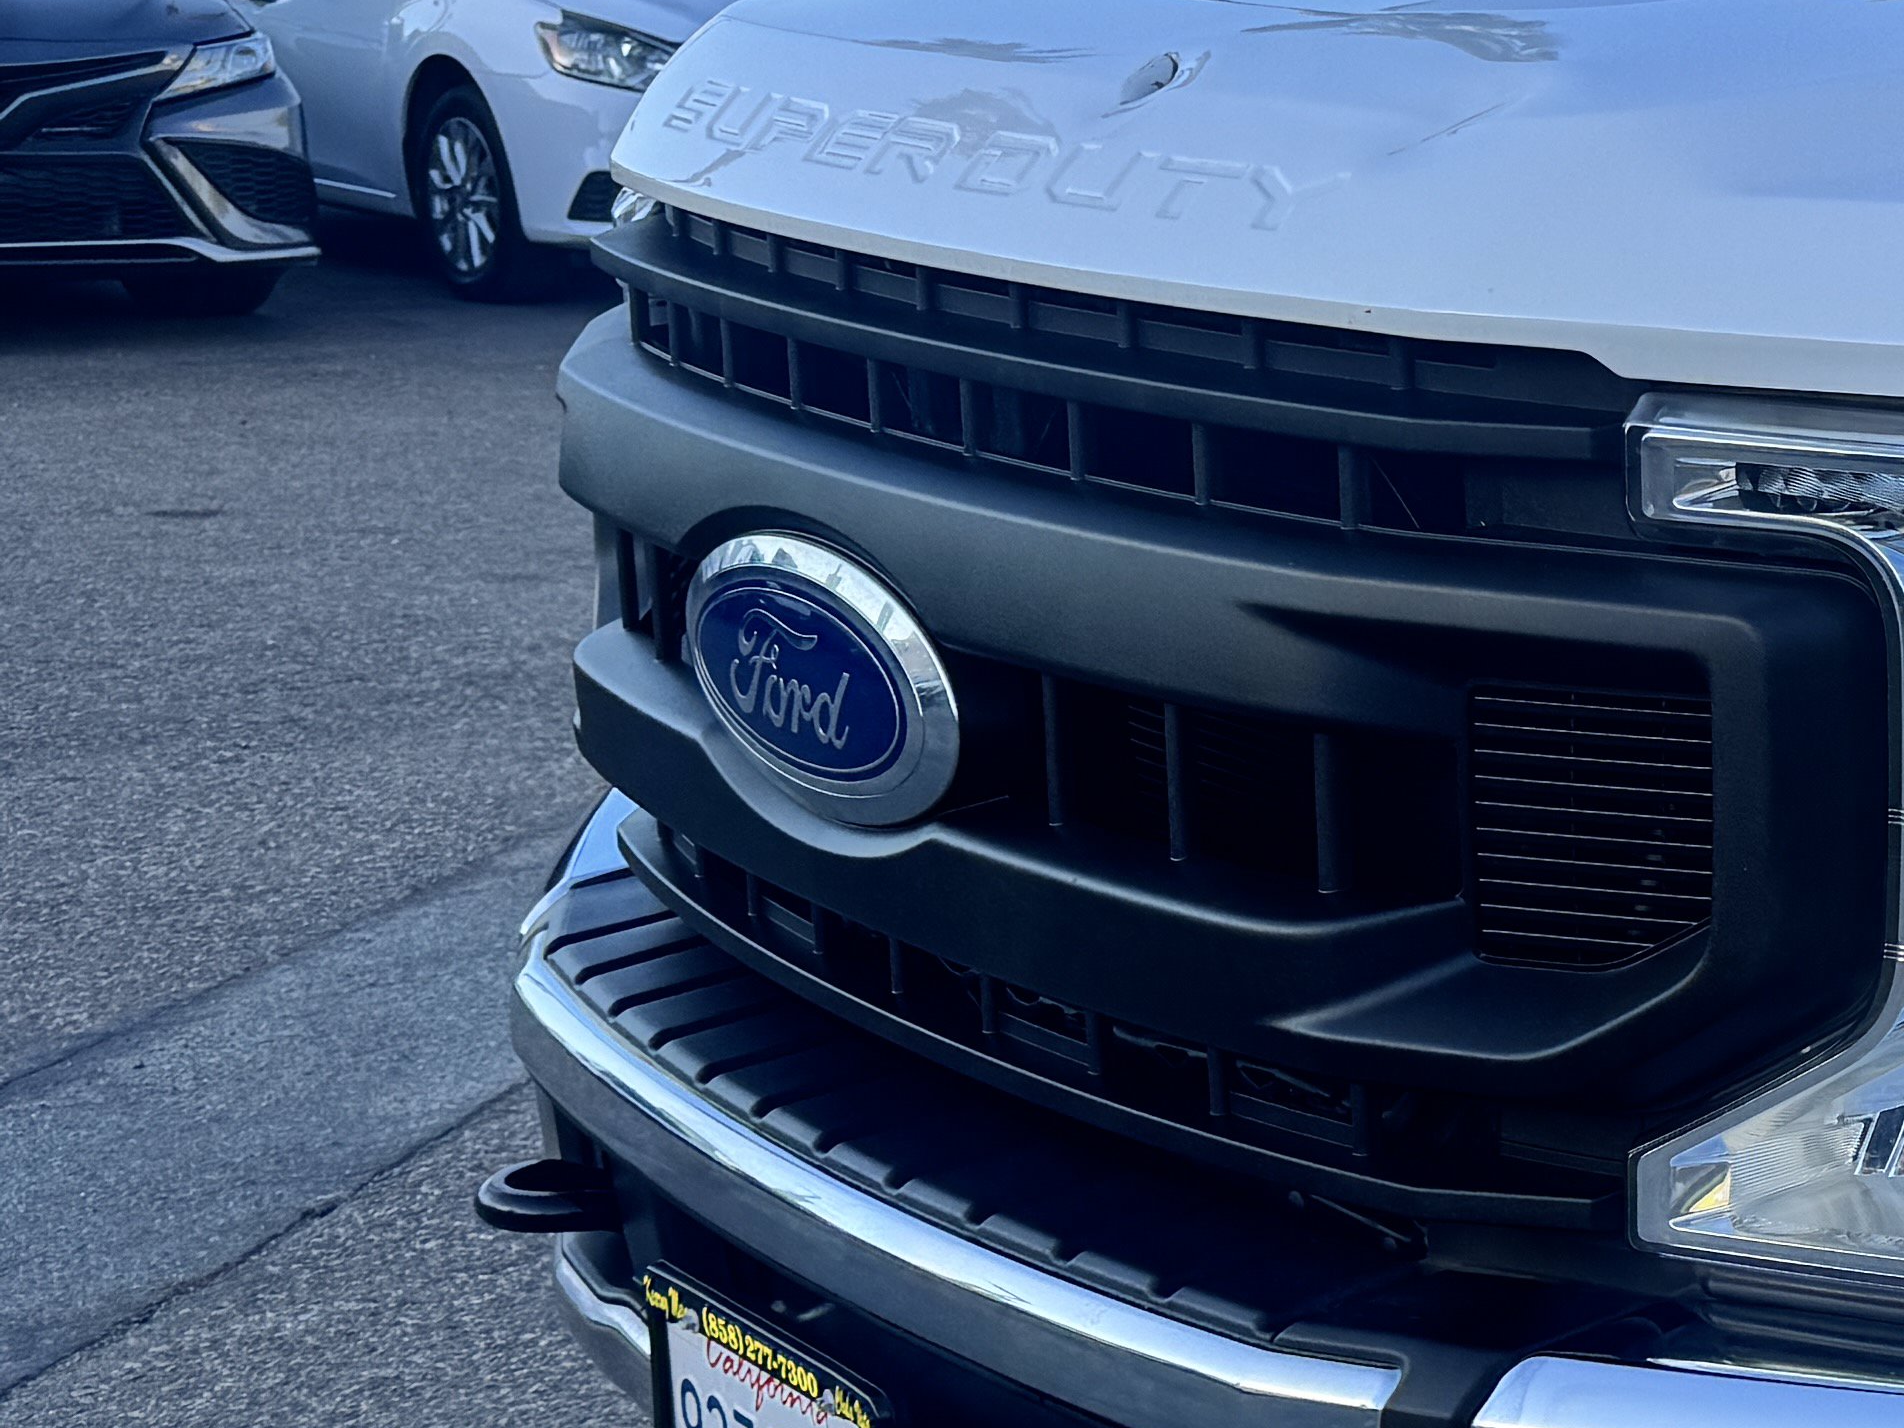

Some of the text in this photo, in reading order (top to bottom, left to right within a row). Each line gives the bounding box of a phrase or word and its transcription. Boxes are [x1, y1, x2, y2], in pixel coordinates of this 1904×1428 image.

[663, 76, 1354, 231] SUPER DUTY
[729, 606, 850, 751] Ford
[701, 1306, 745, 1356] (858)
